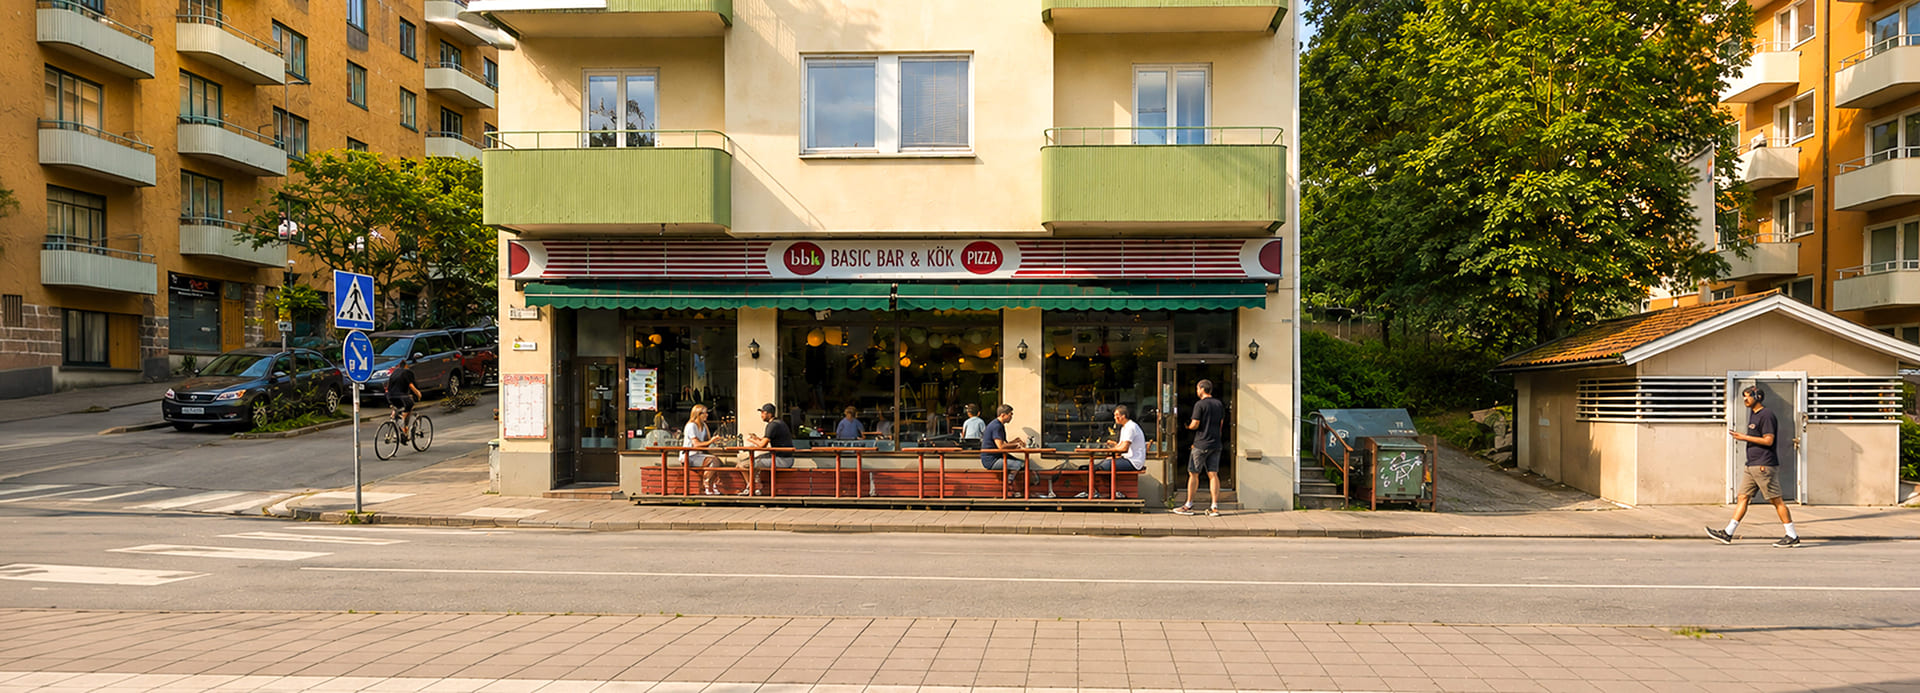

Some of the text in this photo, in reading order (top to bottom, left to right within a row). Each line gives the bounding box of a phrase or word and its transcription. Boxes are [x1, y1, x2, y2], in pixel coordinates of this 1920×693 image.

[791, 249, 820, 266] bbk
[831, 246, 955, 267] BASIC BAR & KÖK
[967, 250, 998, 265] PIZZA
